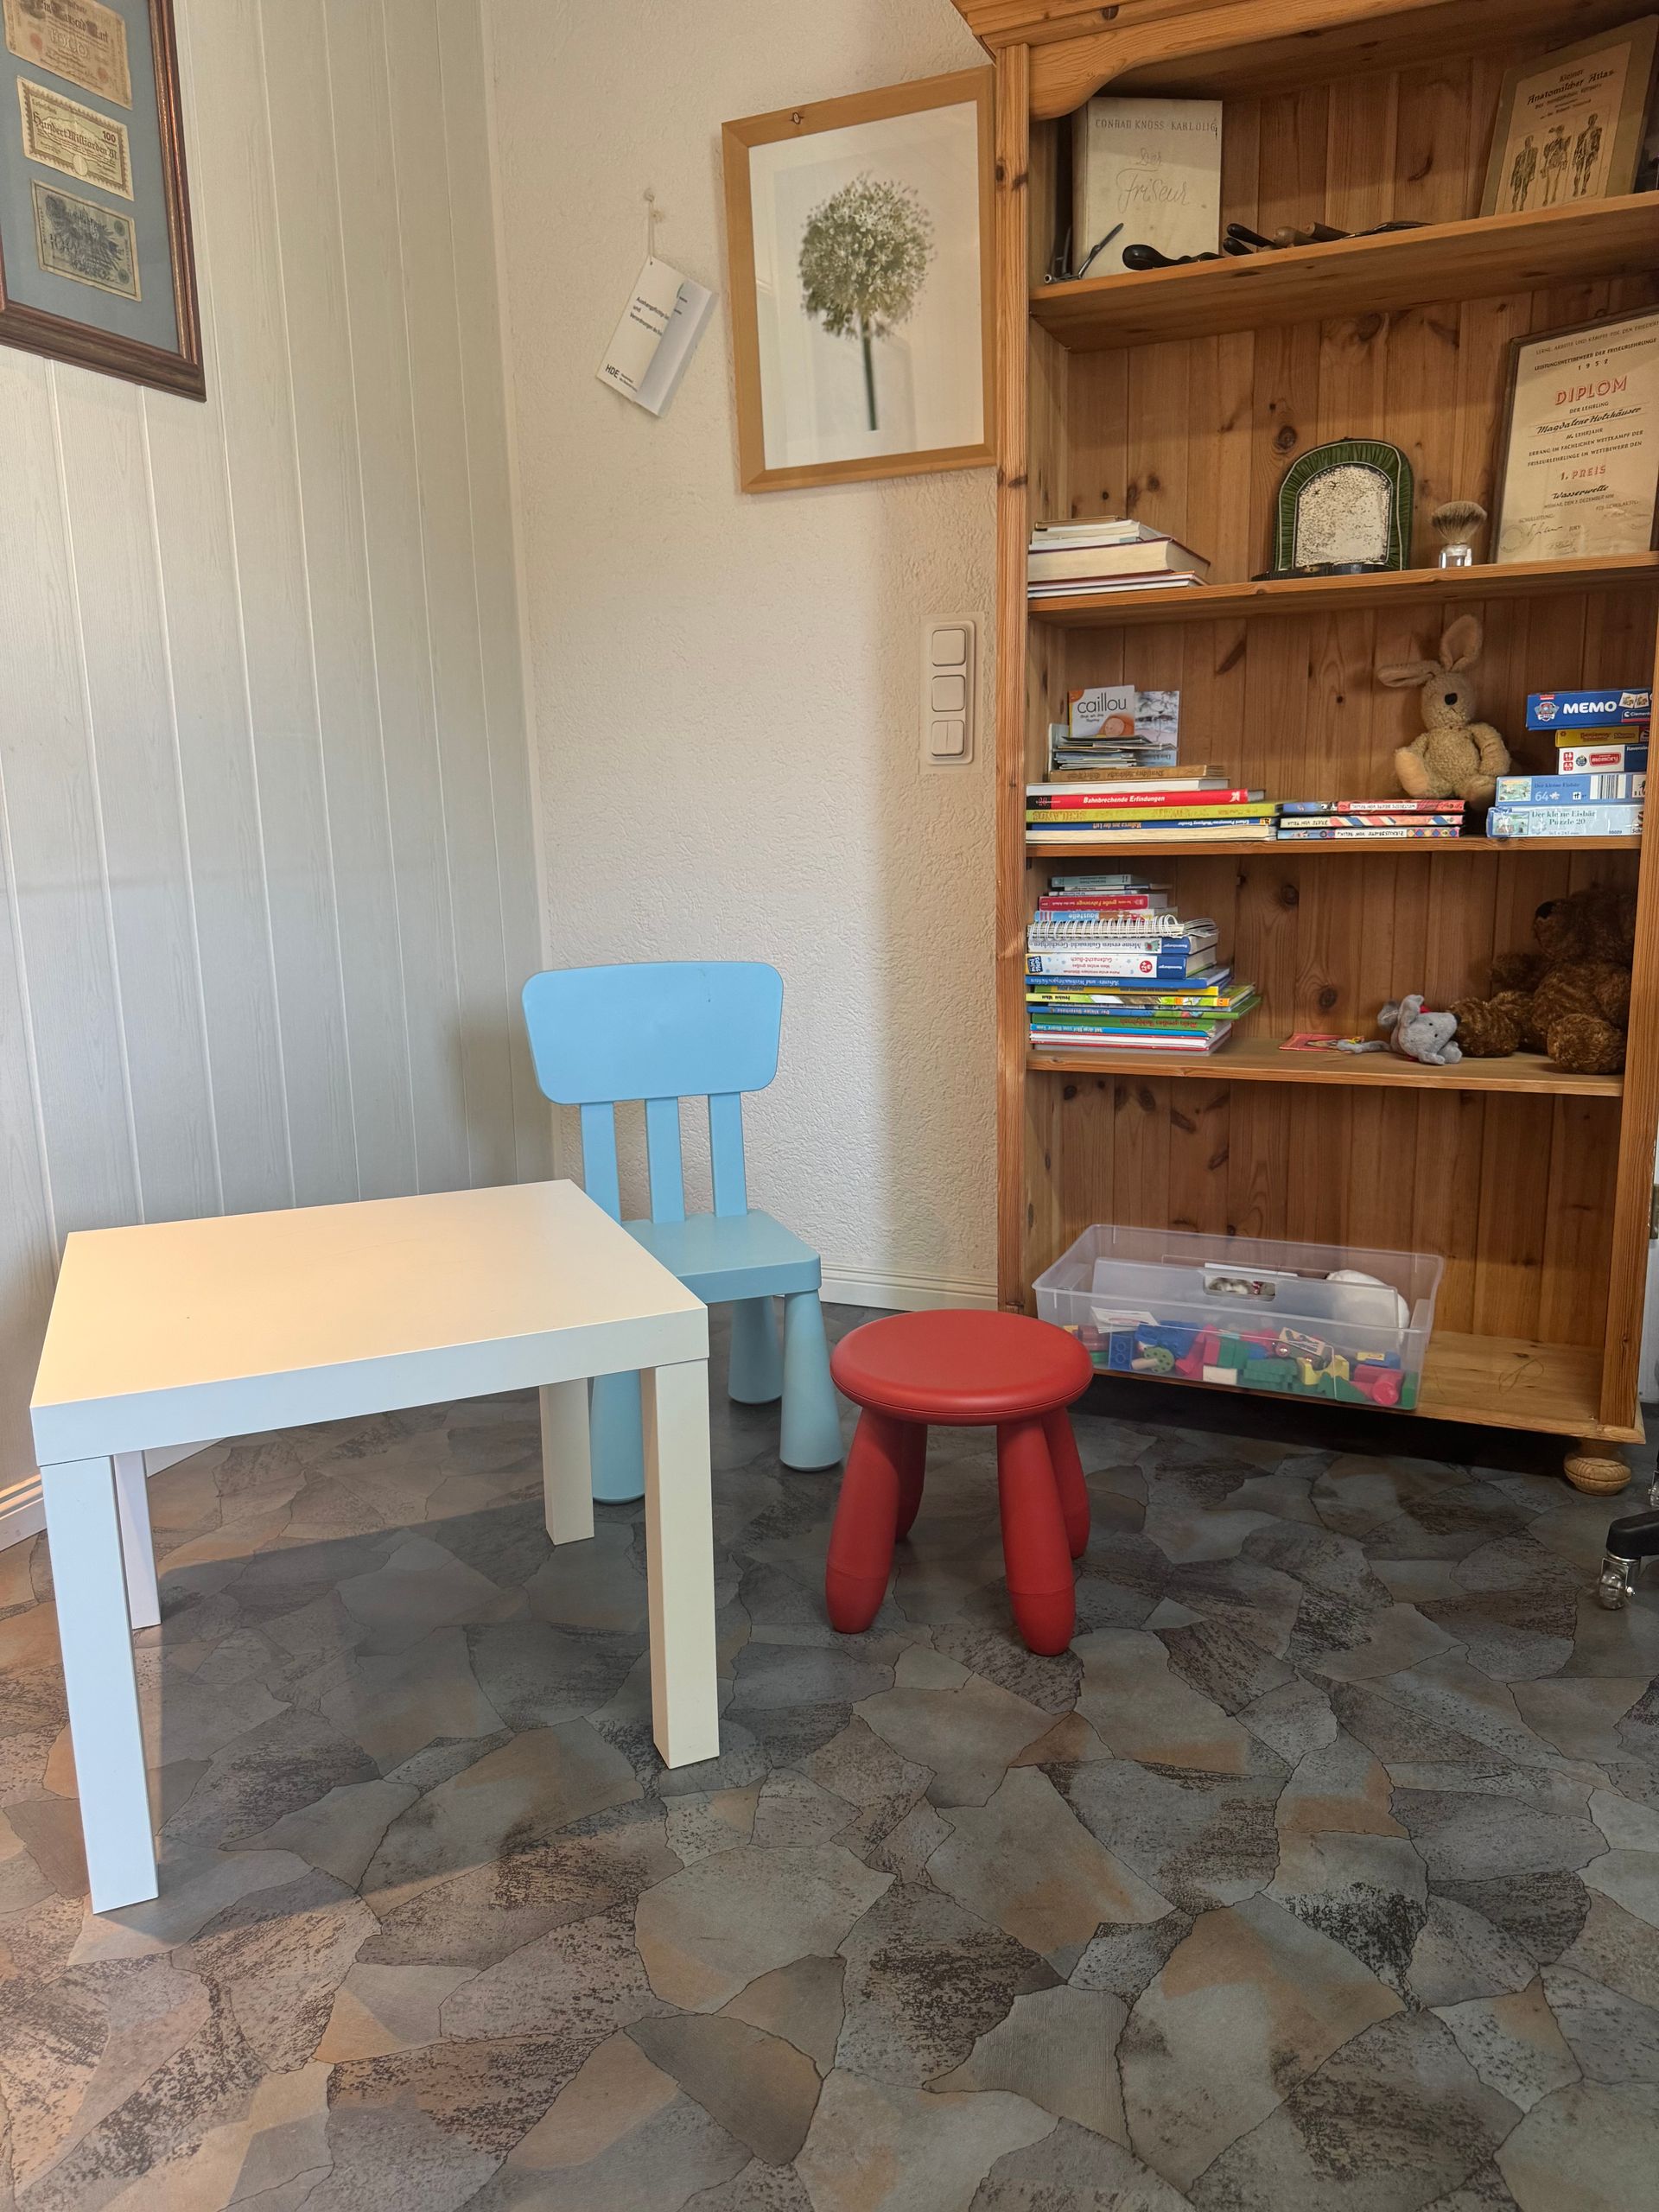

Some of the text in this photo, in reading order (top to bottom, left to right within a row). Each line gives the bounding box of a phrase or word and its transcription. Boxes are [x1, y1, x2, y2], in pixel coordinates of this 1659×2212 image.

[1095, 118, 1132, 130] CONRAD
[102, 130, 117, 143] 100
[605, 363, 620, 378] HDE
[1555, 375, 1628, 406] DIPLOM
[1581, 401, 1609, 411] LEHRLING
[1572, 465, 1607, 480] PREIS
[1077, 692, 1127, 714] caillou
[1562, 701, 1618, 715] MEMO
[1083, 795, 1166, 804] Bahnbrechende Erfindungen
[1535, 791, 1549, 802] 64
